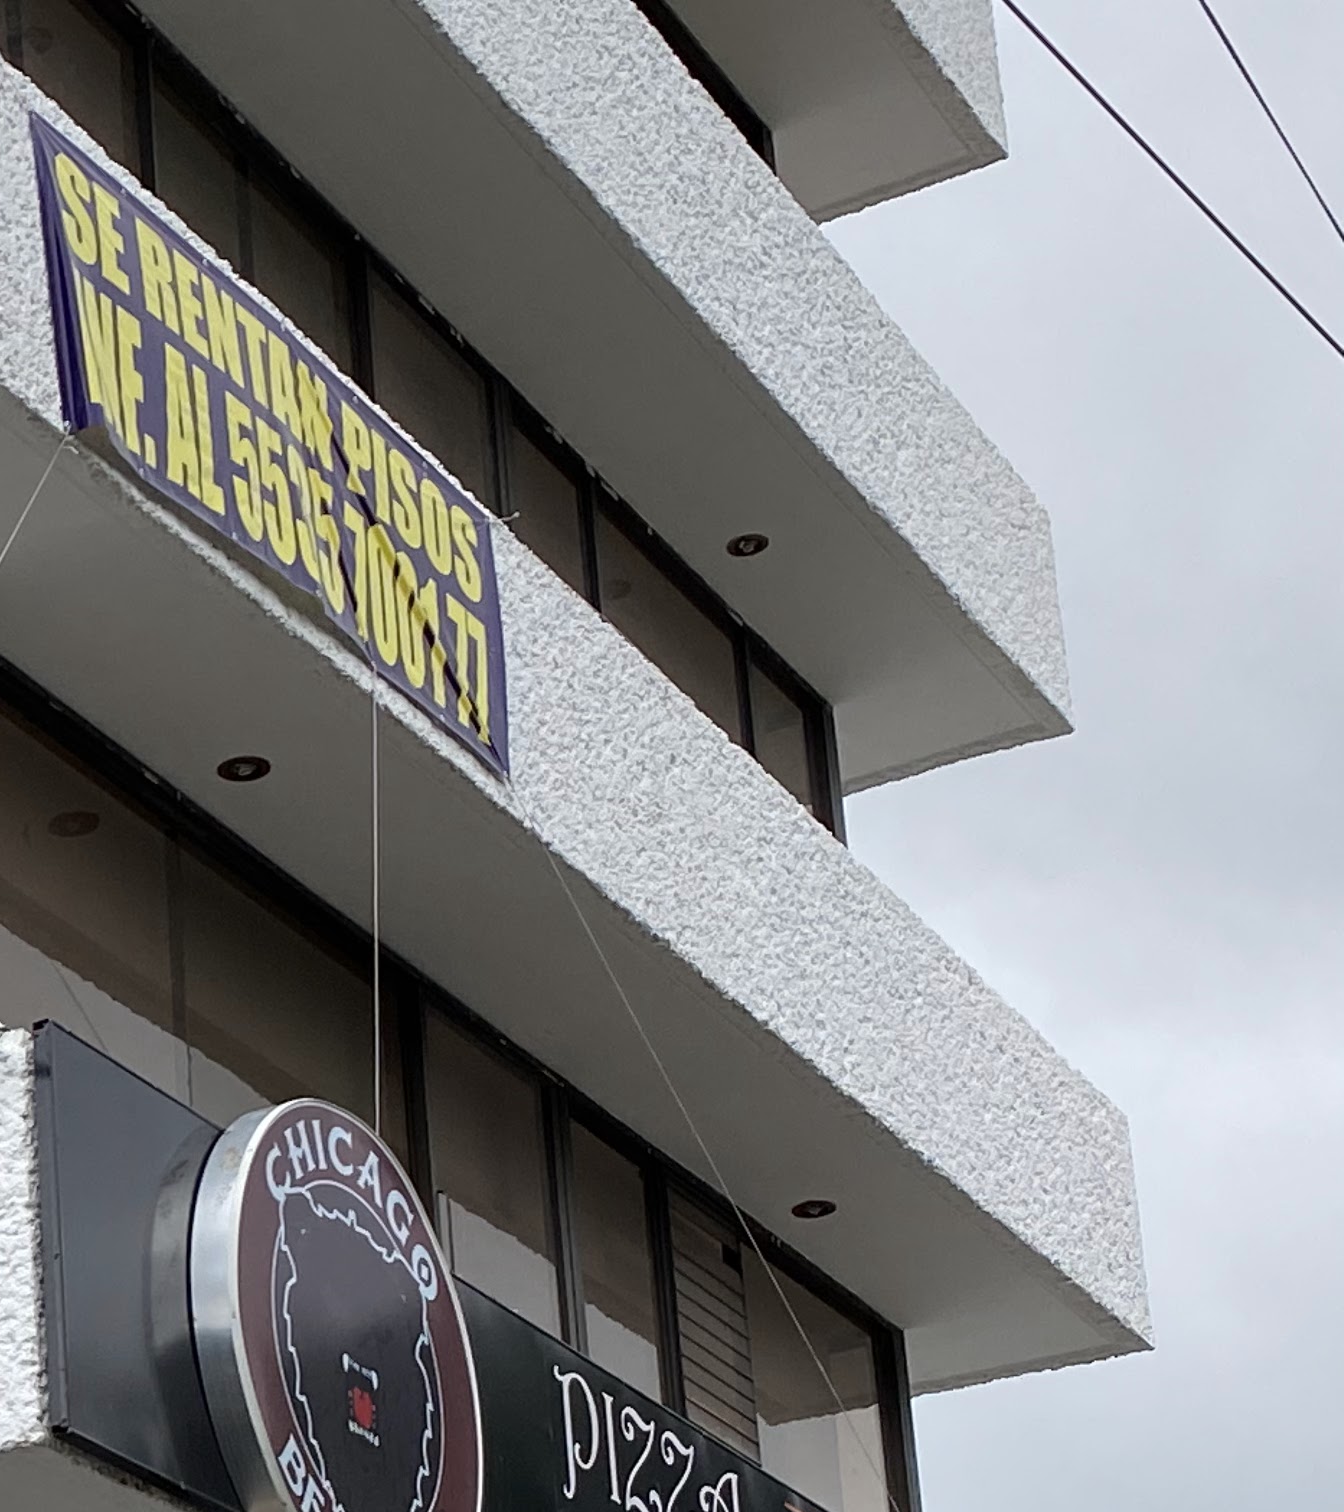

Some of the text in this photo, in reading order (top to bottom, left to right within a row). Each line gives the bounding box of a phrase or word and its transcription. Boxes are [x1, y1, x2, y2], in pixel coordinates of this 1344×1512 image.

[54, 152, 481, 602] SE RENTAN PISOS
[166, 343, 225, 515] AL
[265, 1119, 438, 1300] CHICAGO
